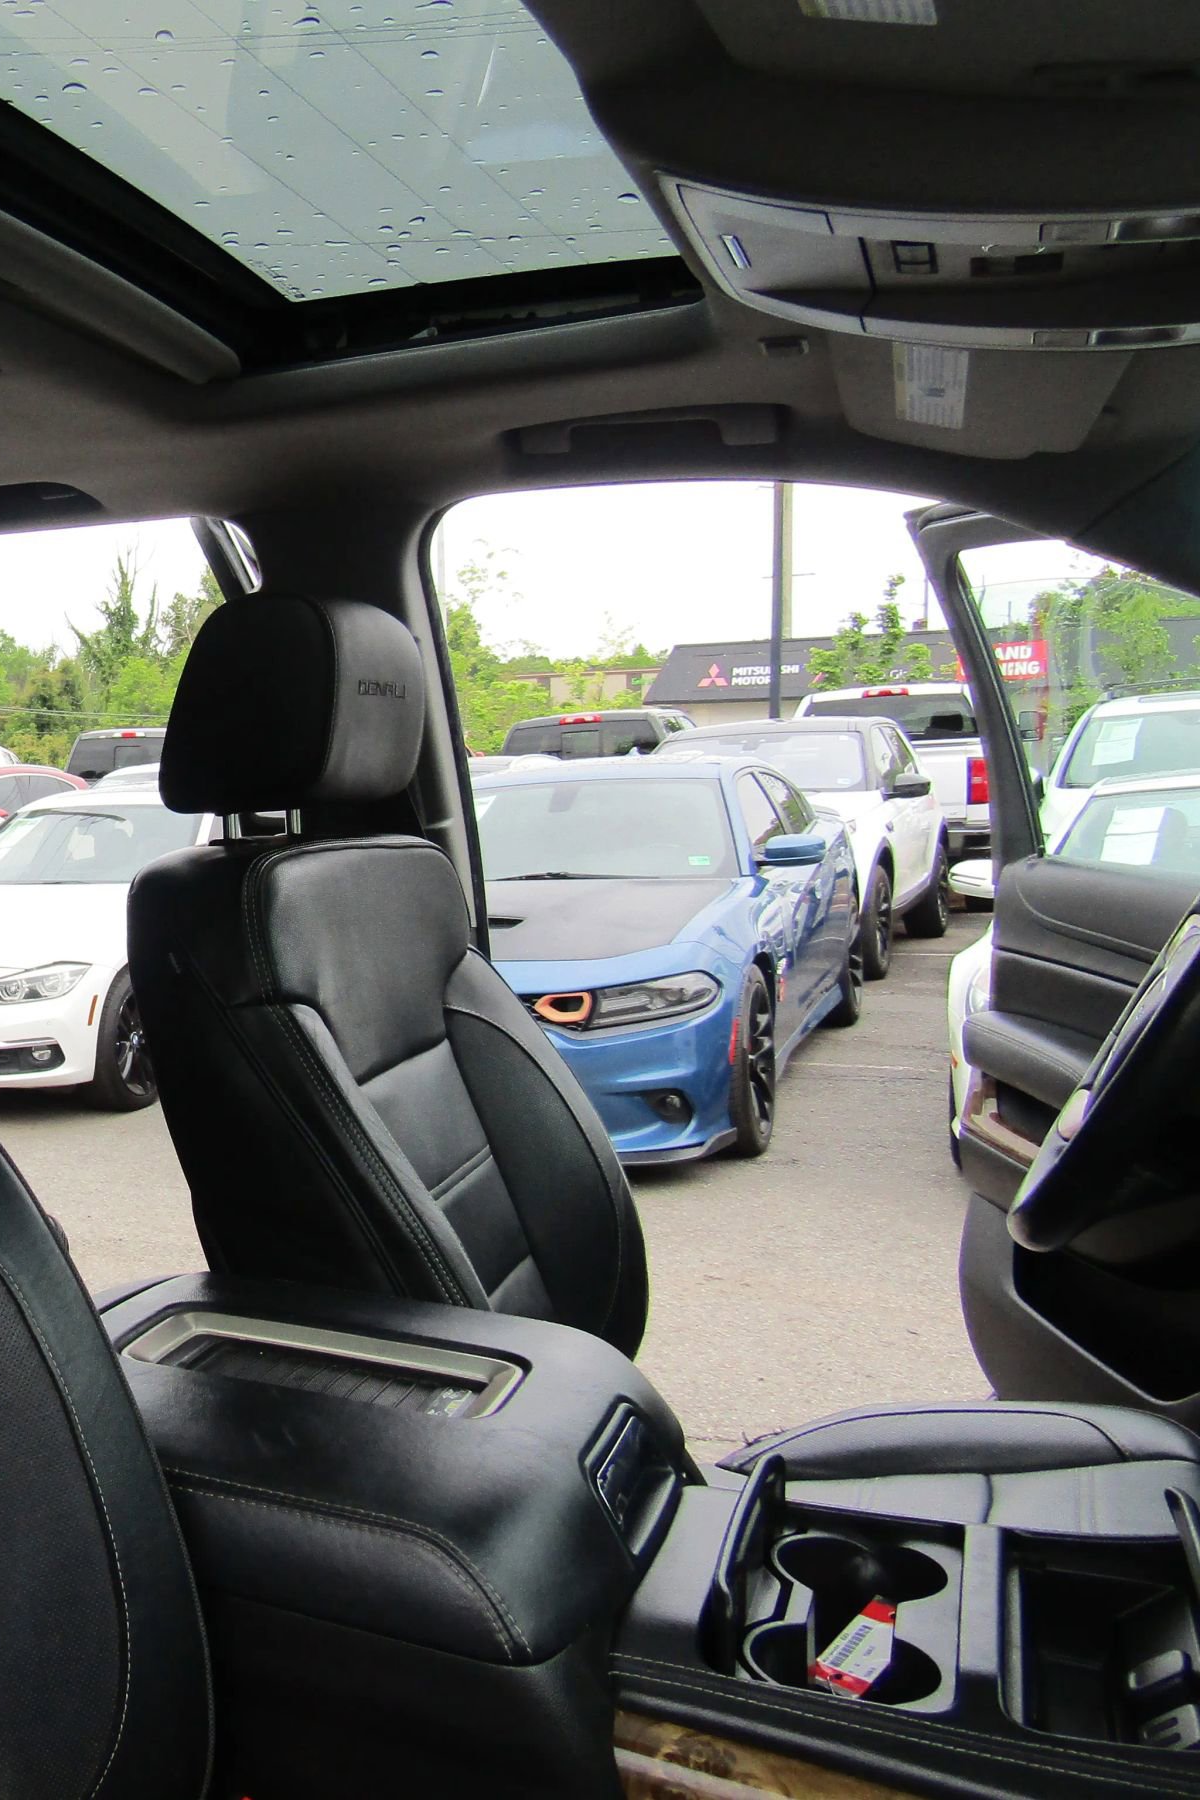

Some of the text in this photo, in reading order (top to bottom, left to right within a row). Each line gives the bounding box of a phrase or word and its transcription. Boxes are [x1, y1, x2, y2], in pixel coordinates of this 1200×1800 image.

[995, 645, 1032, 661] AND
[732, 664, 800, 676] MITSUSHI
[731, 675, 771, 686] MOTOR
